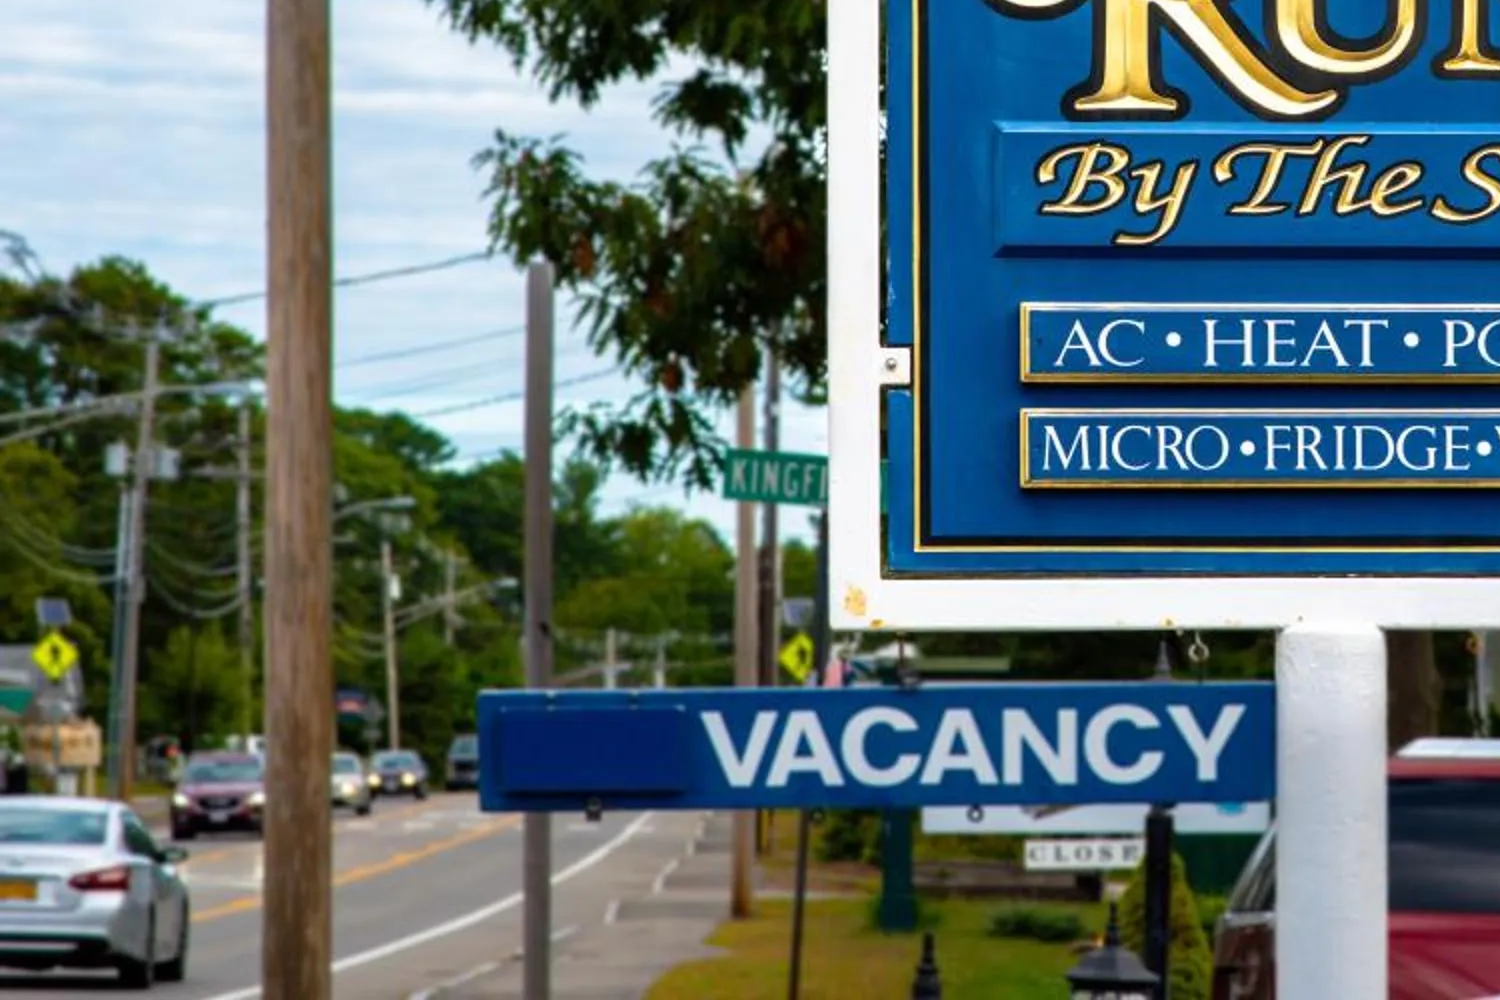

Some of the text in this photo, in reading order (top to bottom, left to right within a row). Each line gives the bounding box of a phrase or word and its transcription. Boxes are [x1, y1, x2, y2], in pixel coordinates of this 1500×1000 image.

[1036, 142, 1198, 245] By
[1212, 135, 1424, 217] The
[1053, 318, 1146, 368] AC
[1202, 318, 1390, 368] HEAT
[1041, 423, 1230, 472] MICRO
[1262, 424, 1472, 471] FRIDGE
[699, 703, 1247, 788] VACANCY
